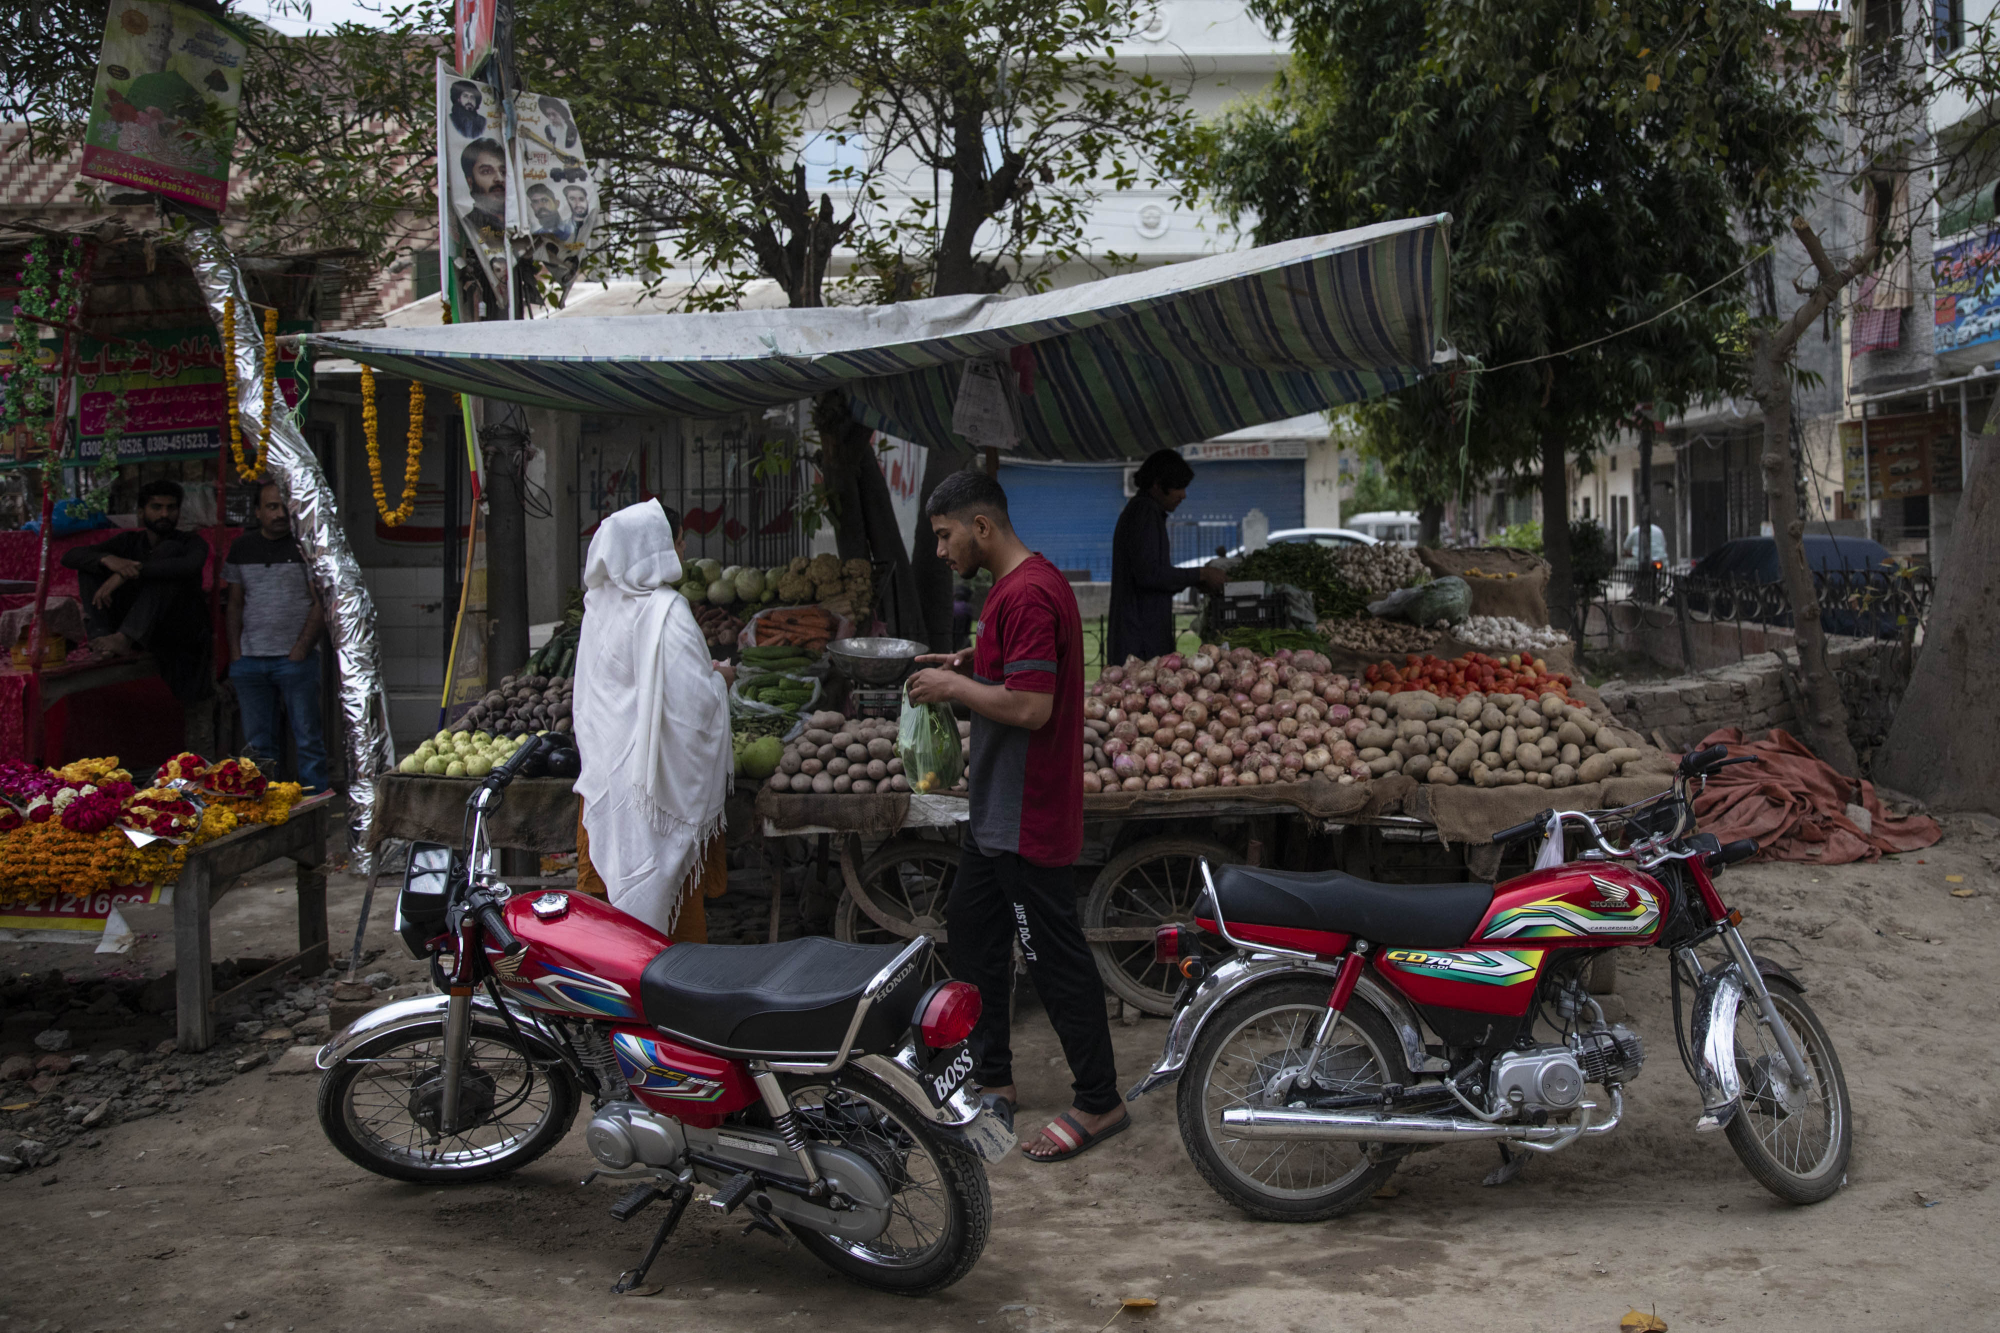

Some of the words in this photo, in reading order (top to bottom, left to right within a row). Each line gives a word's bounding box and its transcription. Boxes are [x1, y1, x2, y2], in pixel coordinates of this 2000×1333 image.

[147, 433, 209, 451] 0309-4515233
[1202, 443, 1269, 458] UTILITIES
[1013, 902, 1028, 926] JUST
[1018, 927, 1031, 940] DO
[1025, 952, 1037, 961] IT
[496, 973, 532, 984] HONDA
[876, 962, 916, 1003] HONDA
[933, 1048, 974, 1102] BOSS
